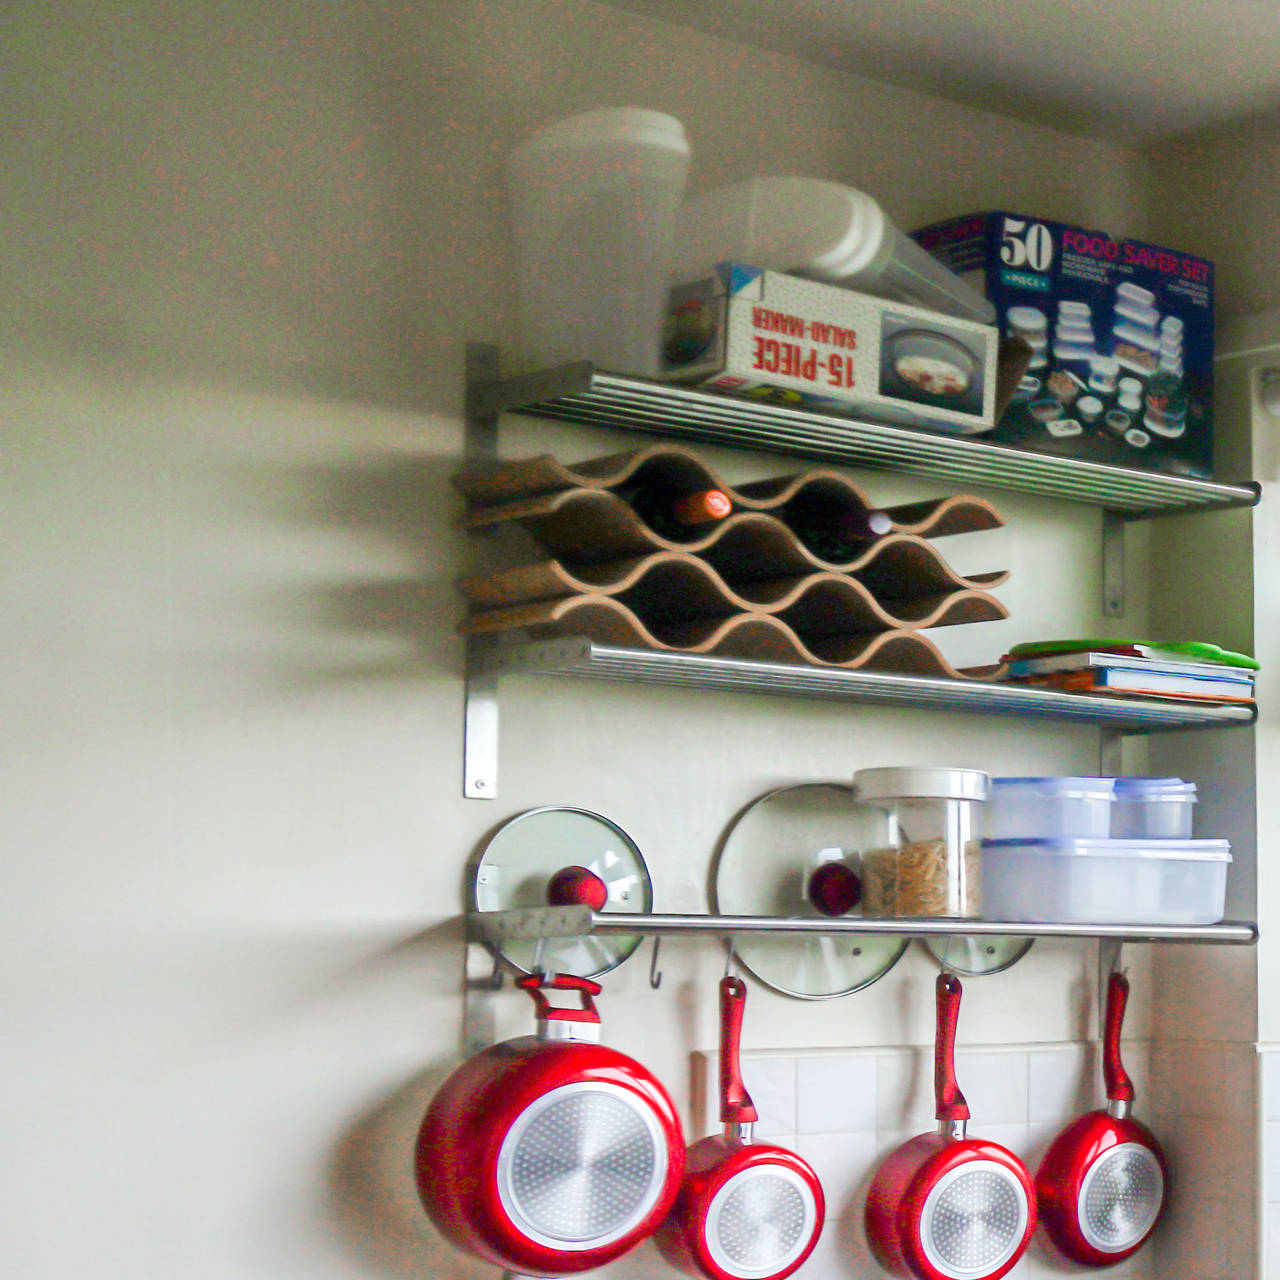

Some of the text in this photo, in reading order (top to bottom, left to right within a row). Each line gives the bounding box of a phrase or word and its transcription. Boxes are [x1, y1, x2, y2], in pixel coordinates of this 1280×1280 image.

[1000, 217, 1053, 272] 50
[1062, 231, 1119, 260] FOOD
[1123, 245, 1177, 275] SAVER
[1181, 259, 1209, 282] SET
[752, 306, 857, 351] SALAD-MAKER
[752, 336, 856, 389] 15-PIECE
